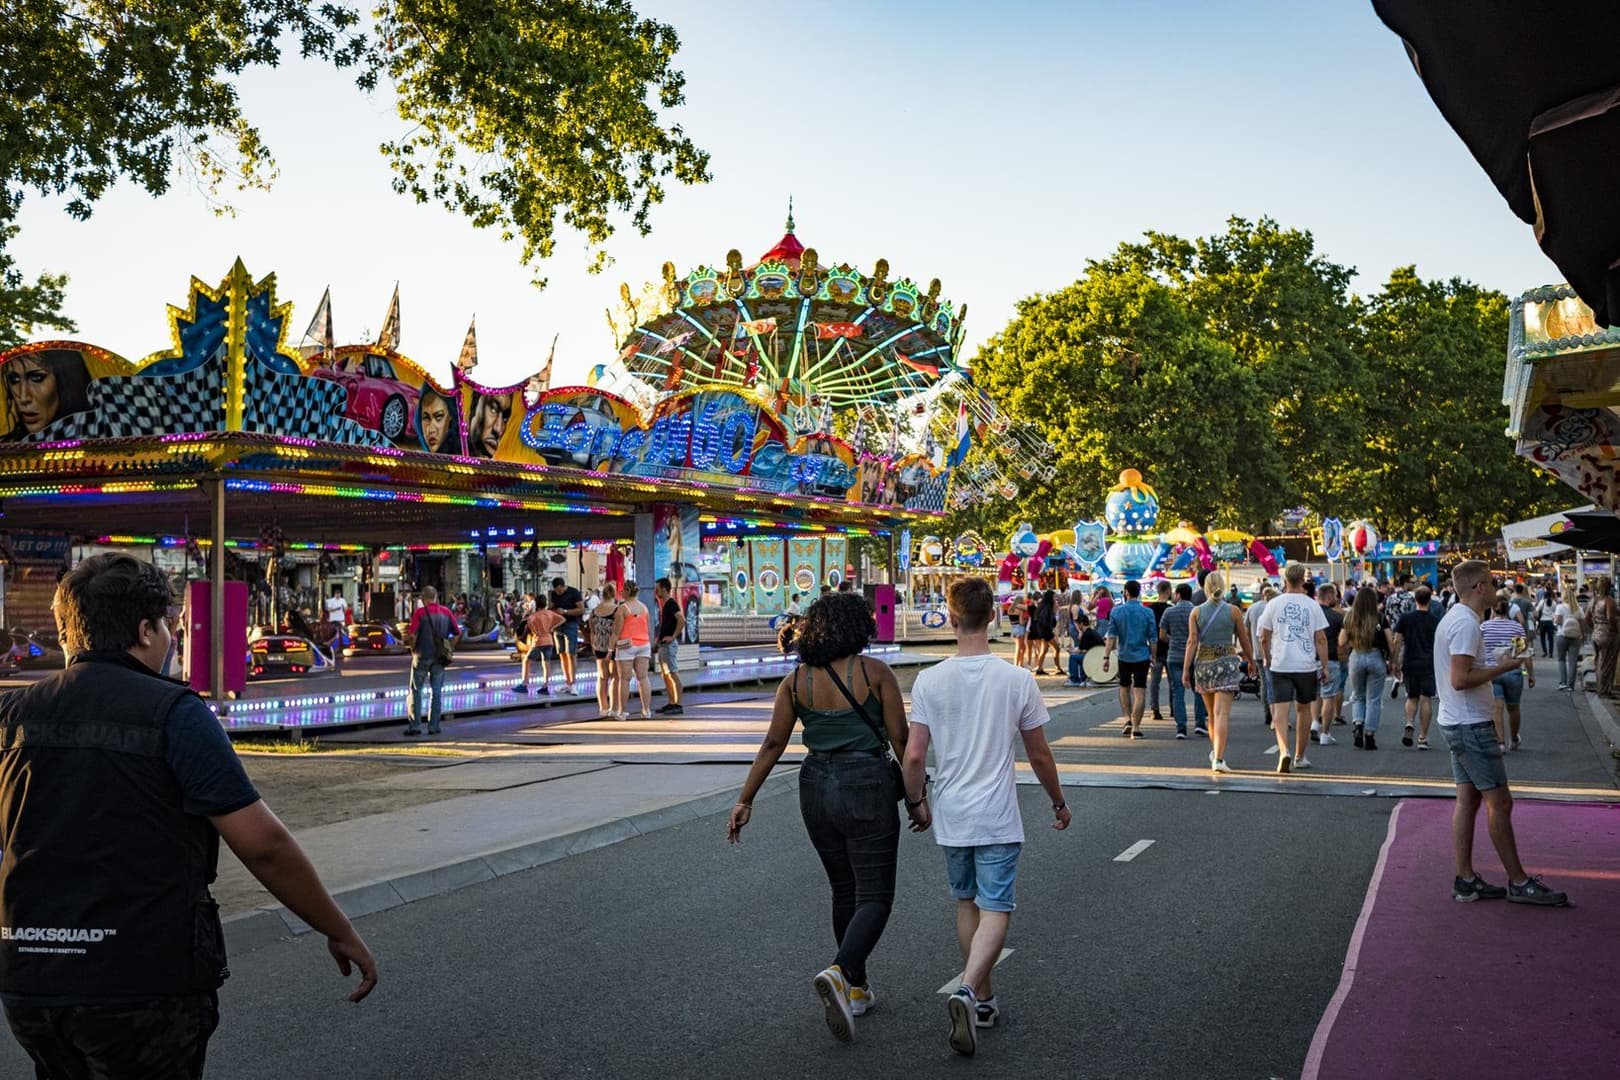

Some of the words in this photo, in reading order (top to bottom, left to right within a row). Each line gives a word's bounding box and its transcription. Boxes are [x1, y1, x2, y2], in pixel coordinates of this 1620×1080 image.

[690, 400, 755, 474] 60
[12, 540, 34, 551] LET
[35, 540, 52, 552] OP
